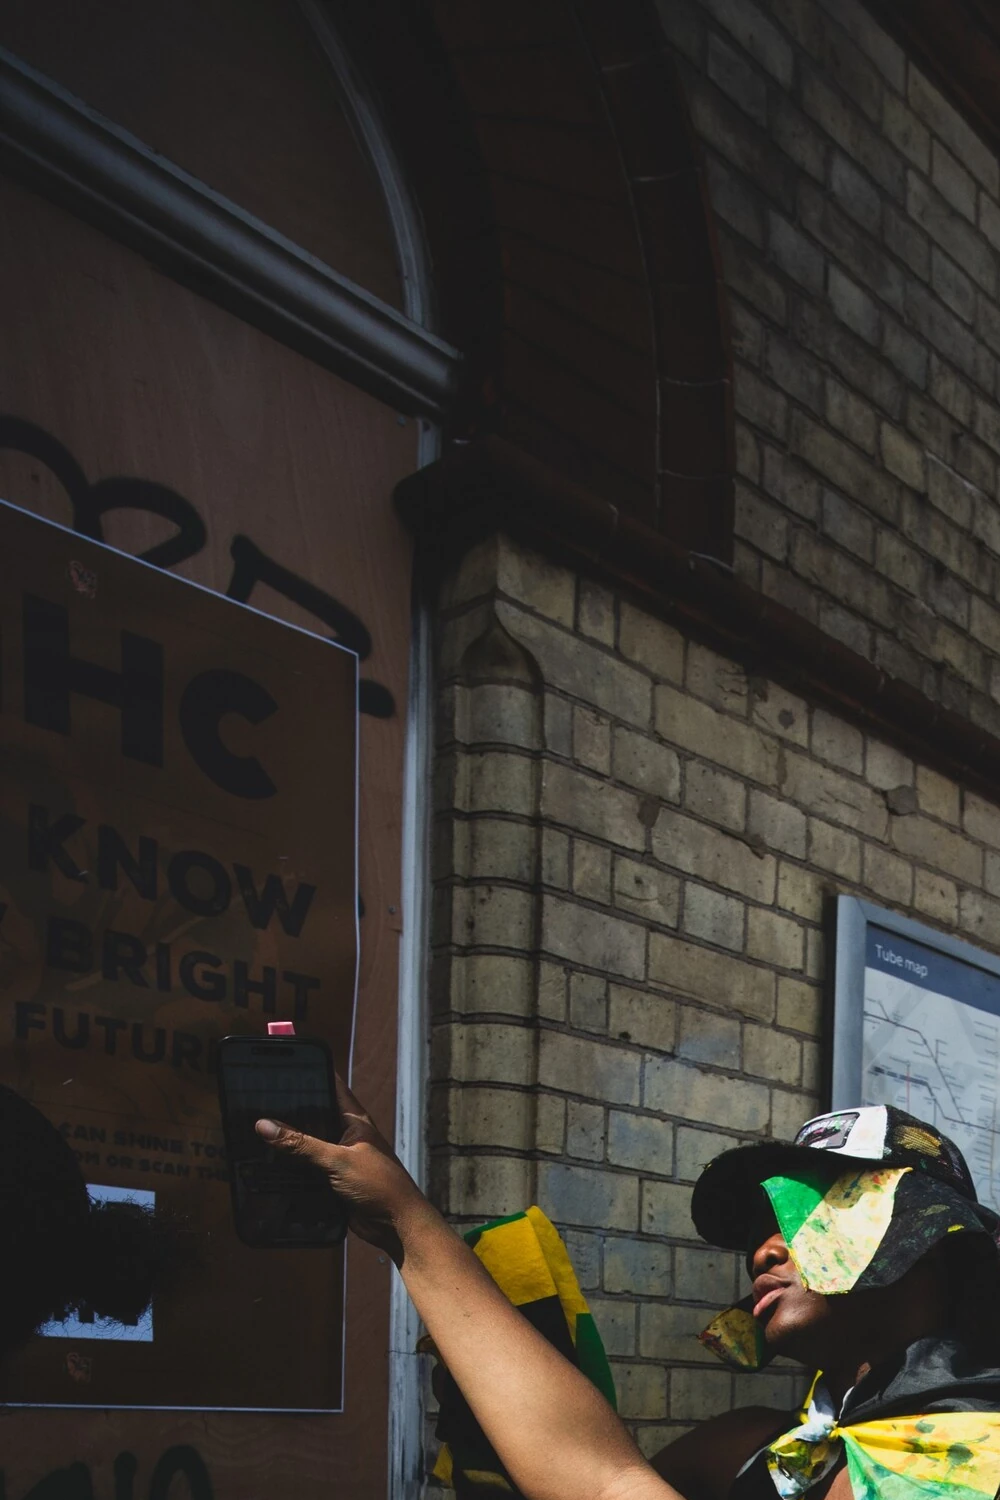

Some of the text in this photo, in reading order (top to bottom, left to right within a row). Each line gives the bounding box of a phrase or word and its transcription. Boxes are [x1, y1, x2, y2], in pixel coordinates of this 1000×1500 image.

[28, 803, 317, 938] KNOW
[46, 914, 321, 1021] BRIGHT
[875, 943, 928, 979] Tube map
[113, 1130, 184, 1154] SHINE
[106, 1153, 134, 1169] OR
[139, 1158, 191, 1177] SCAN
